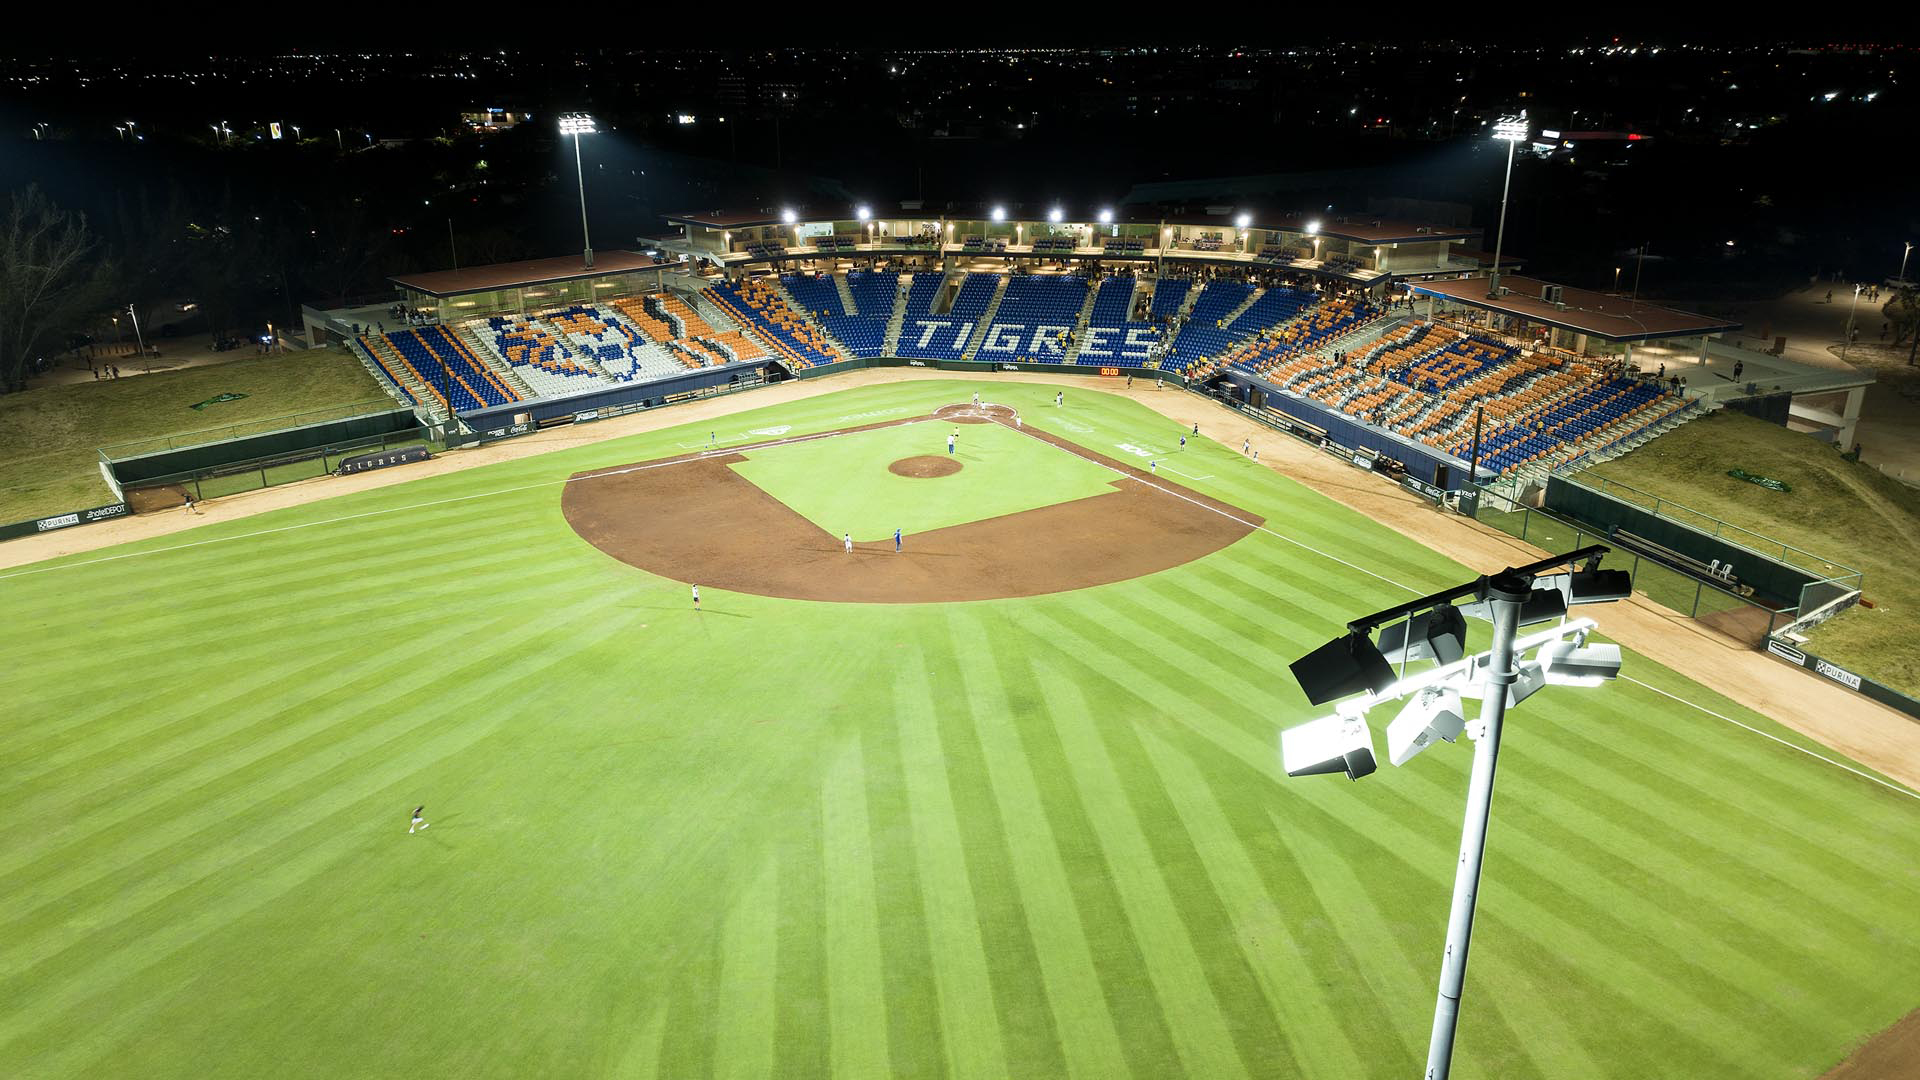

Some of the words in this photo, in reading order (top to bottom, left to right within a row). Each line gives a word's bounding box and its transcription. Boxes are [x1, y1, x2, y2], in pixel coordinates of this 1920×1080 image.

[916, 320, 1160, 357] TIGRES
[345, 454, 407, 471] TIGRES
[47, 517, 77, 527] PURINA
[1826, 666, 1858, 687] PURINA
